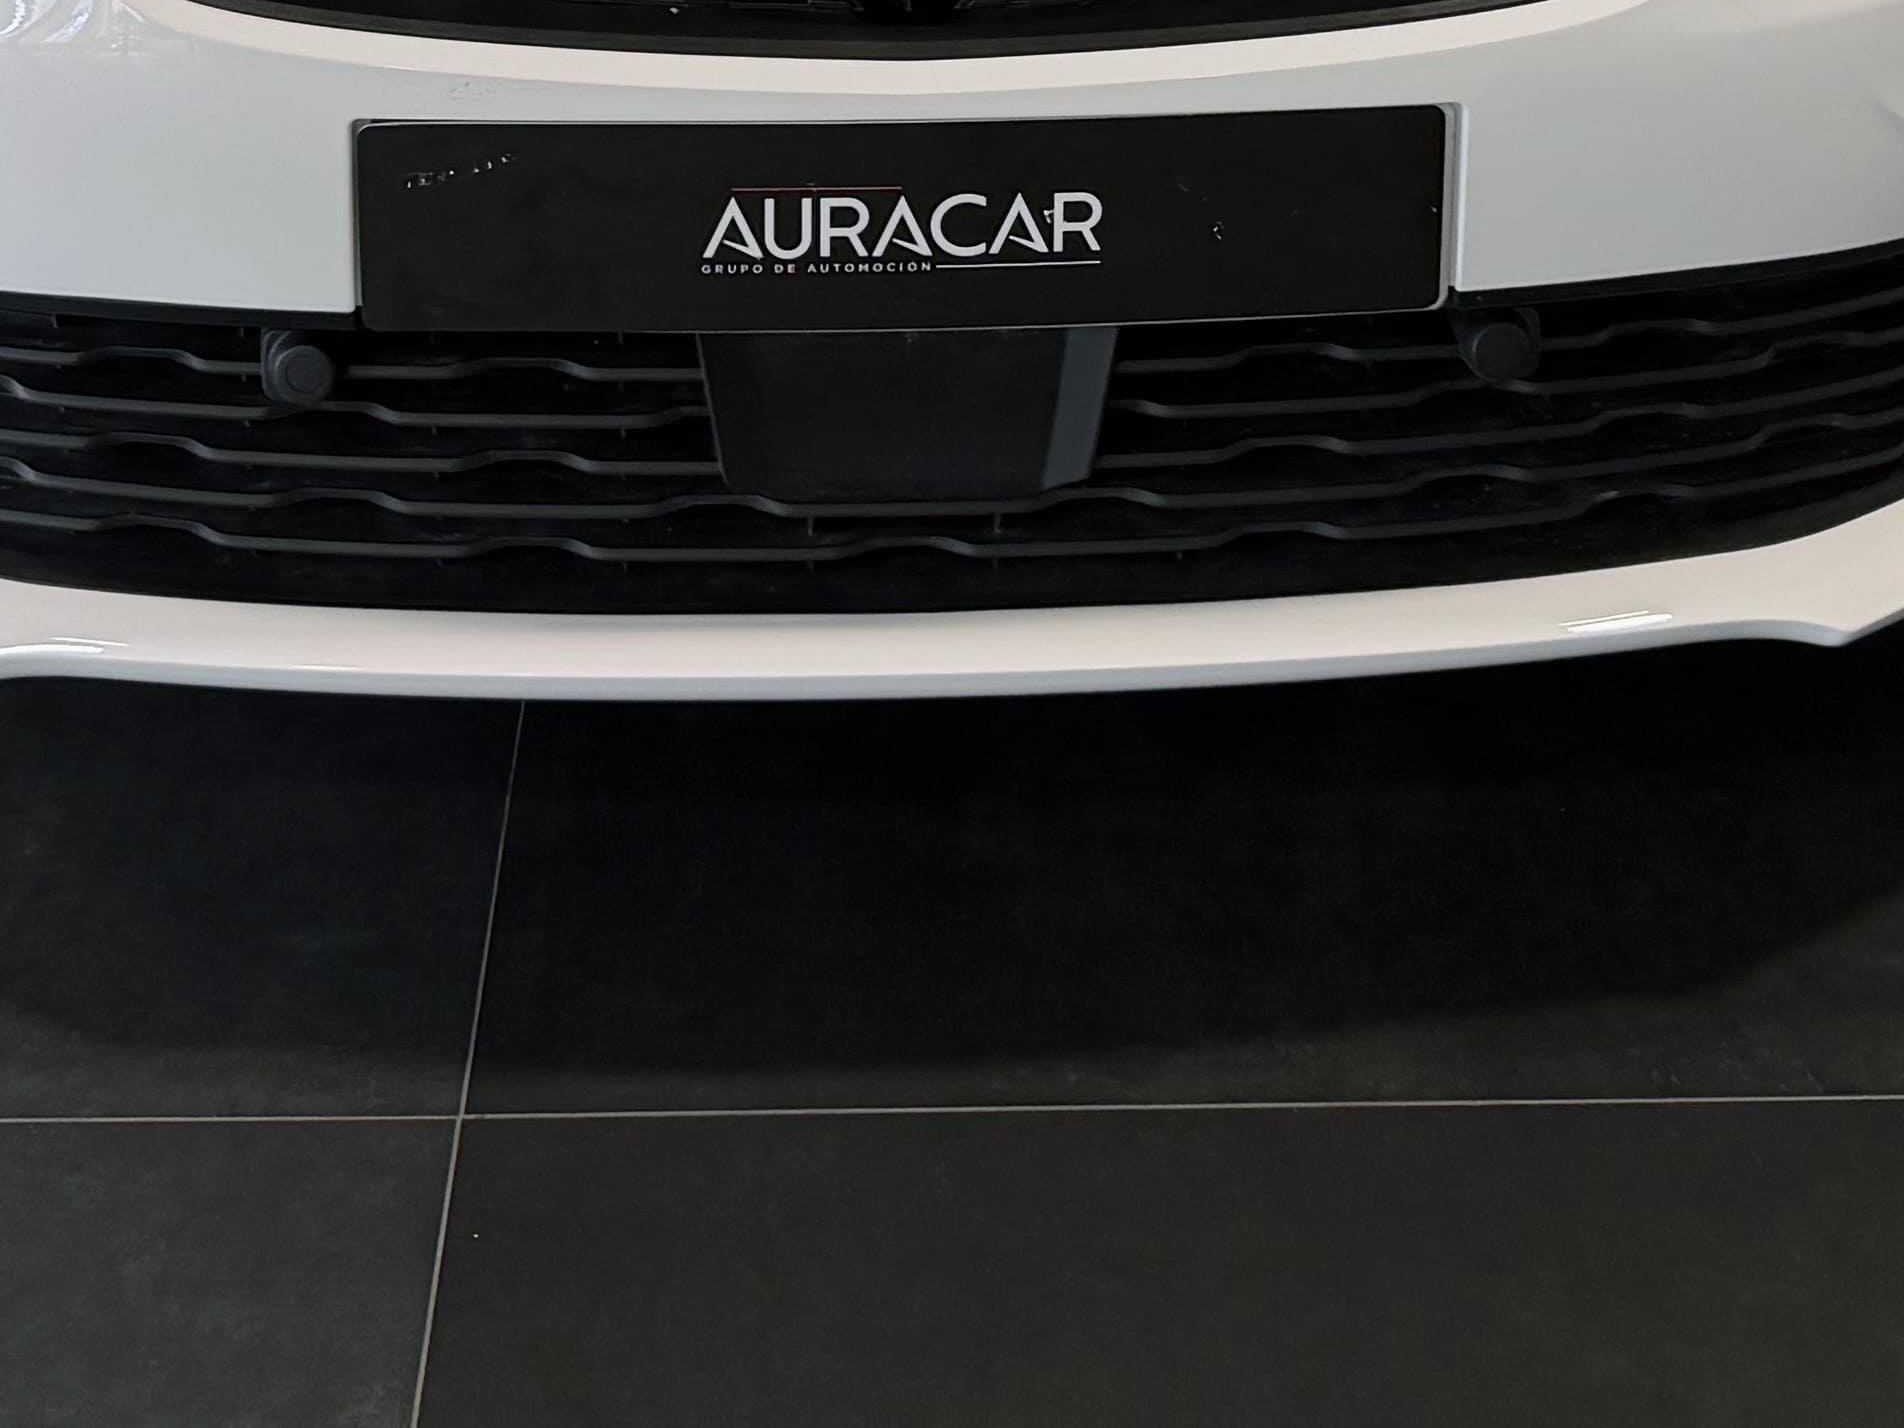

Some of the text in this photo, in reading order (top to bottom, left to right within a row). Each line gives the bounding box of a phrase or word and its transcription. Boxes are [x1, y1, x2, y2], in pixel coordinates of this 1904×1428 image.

[702, 191, 1104, 261] AURACAR
[701, 264, 764, 274] GRUPO
[774, 264, 796, 274] DE
